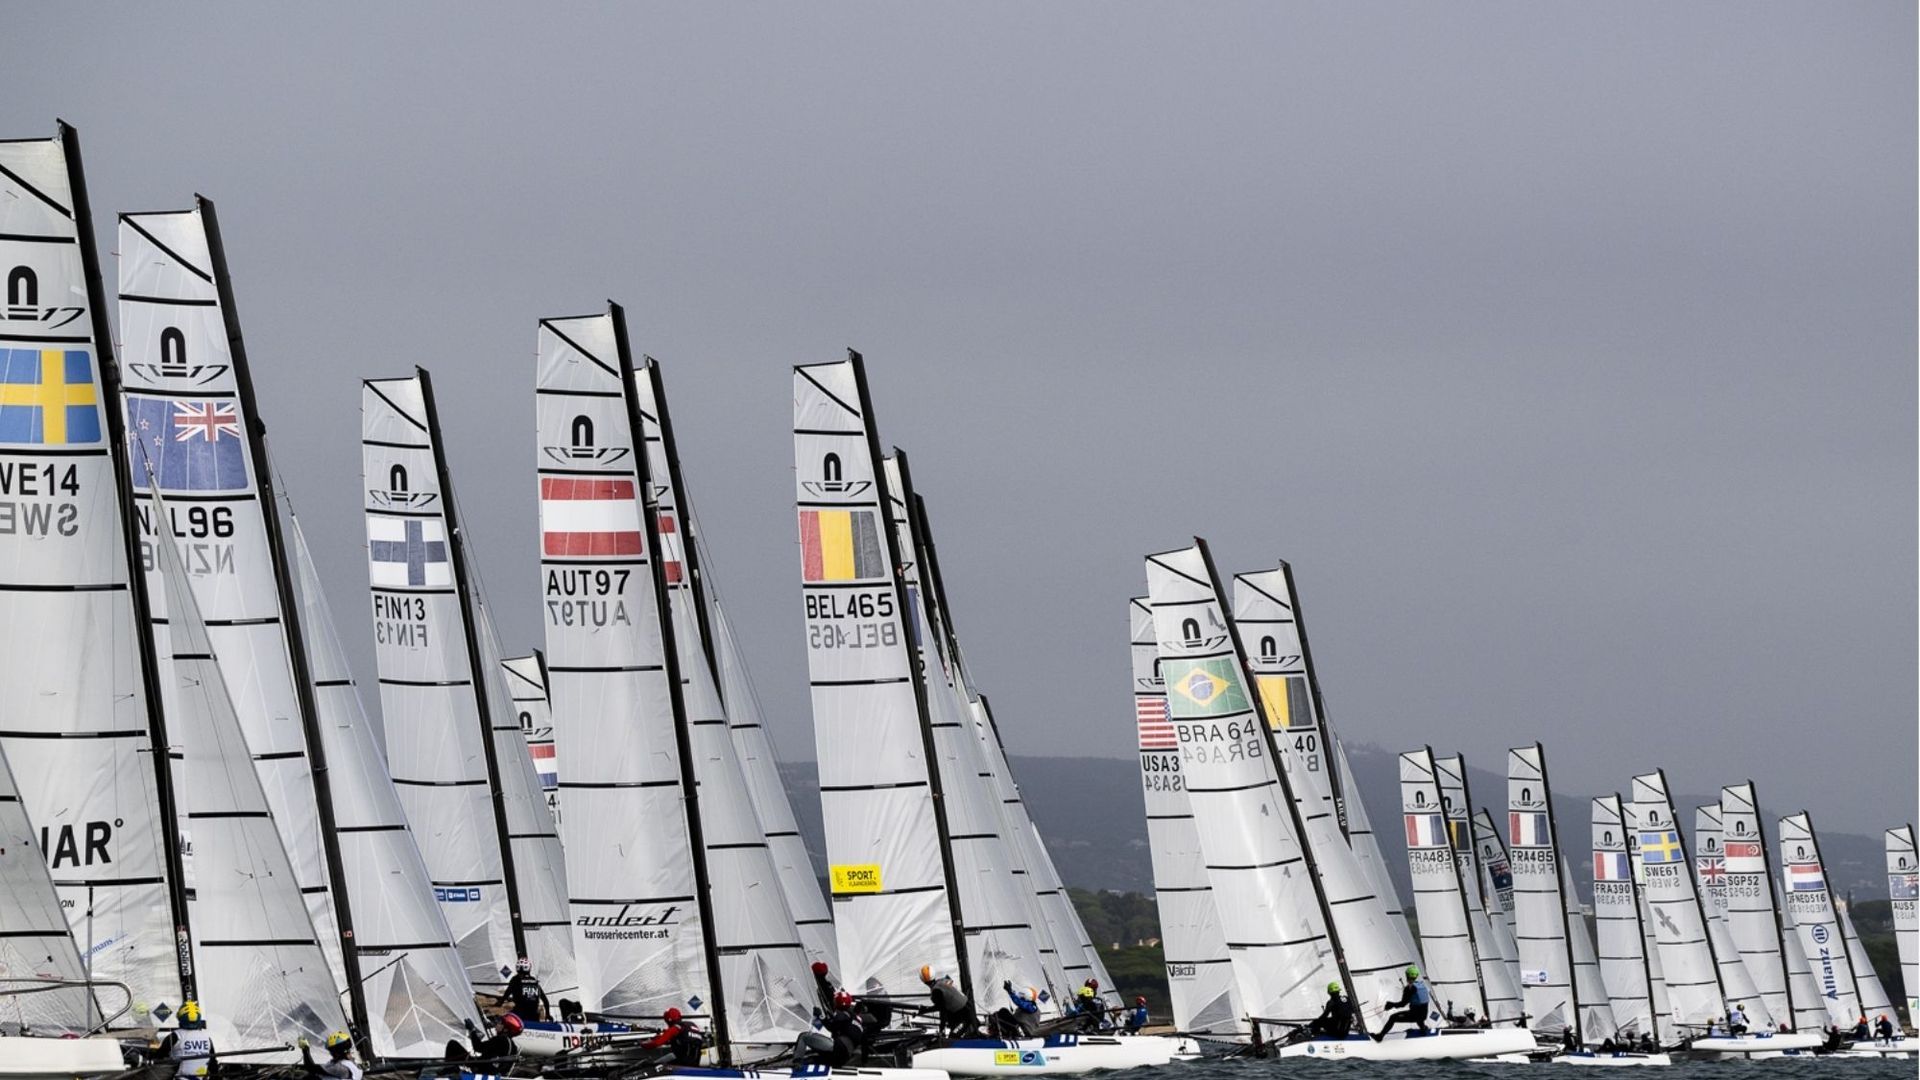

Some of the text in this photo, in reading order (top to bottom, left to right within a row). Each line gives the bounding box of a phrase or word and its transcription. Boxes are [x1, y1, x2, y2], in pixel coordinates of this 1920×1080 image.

[137, 505, 235, 538] NL96
[547, 569, 631, 597] AUT97
[374, 595, 425, 621] FIN13
[806, 593, 894, 619] BEL465
[1409, 851, 1451, 863] FRA483
[1512, 851, 1554, 863] FRA485
[1645, 865, 1678, 876] SWE61
[1728, 876, 1760, 886] SGP52
[1596, 884, 1631, 894] FRA390
[584, 928, 670, 941] karosseriecenter.at
[1820, 947, 1839, 1000] Allianz
[184, 1040, 209, 1050] SWE
